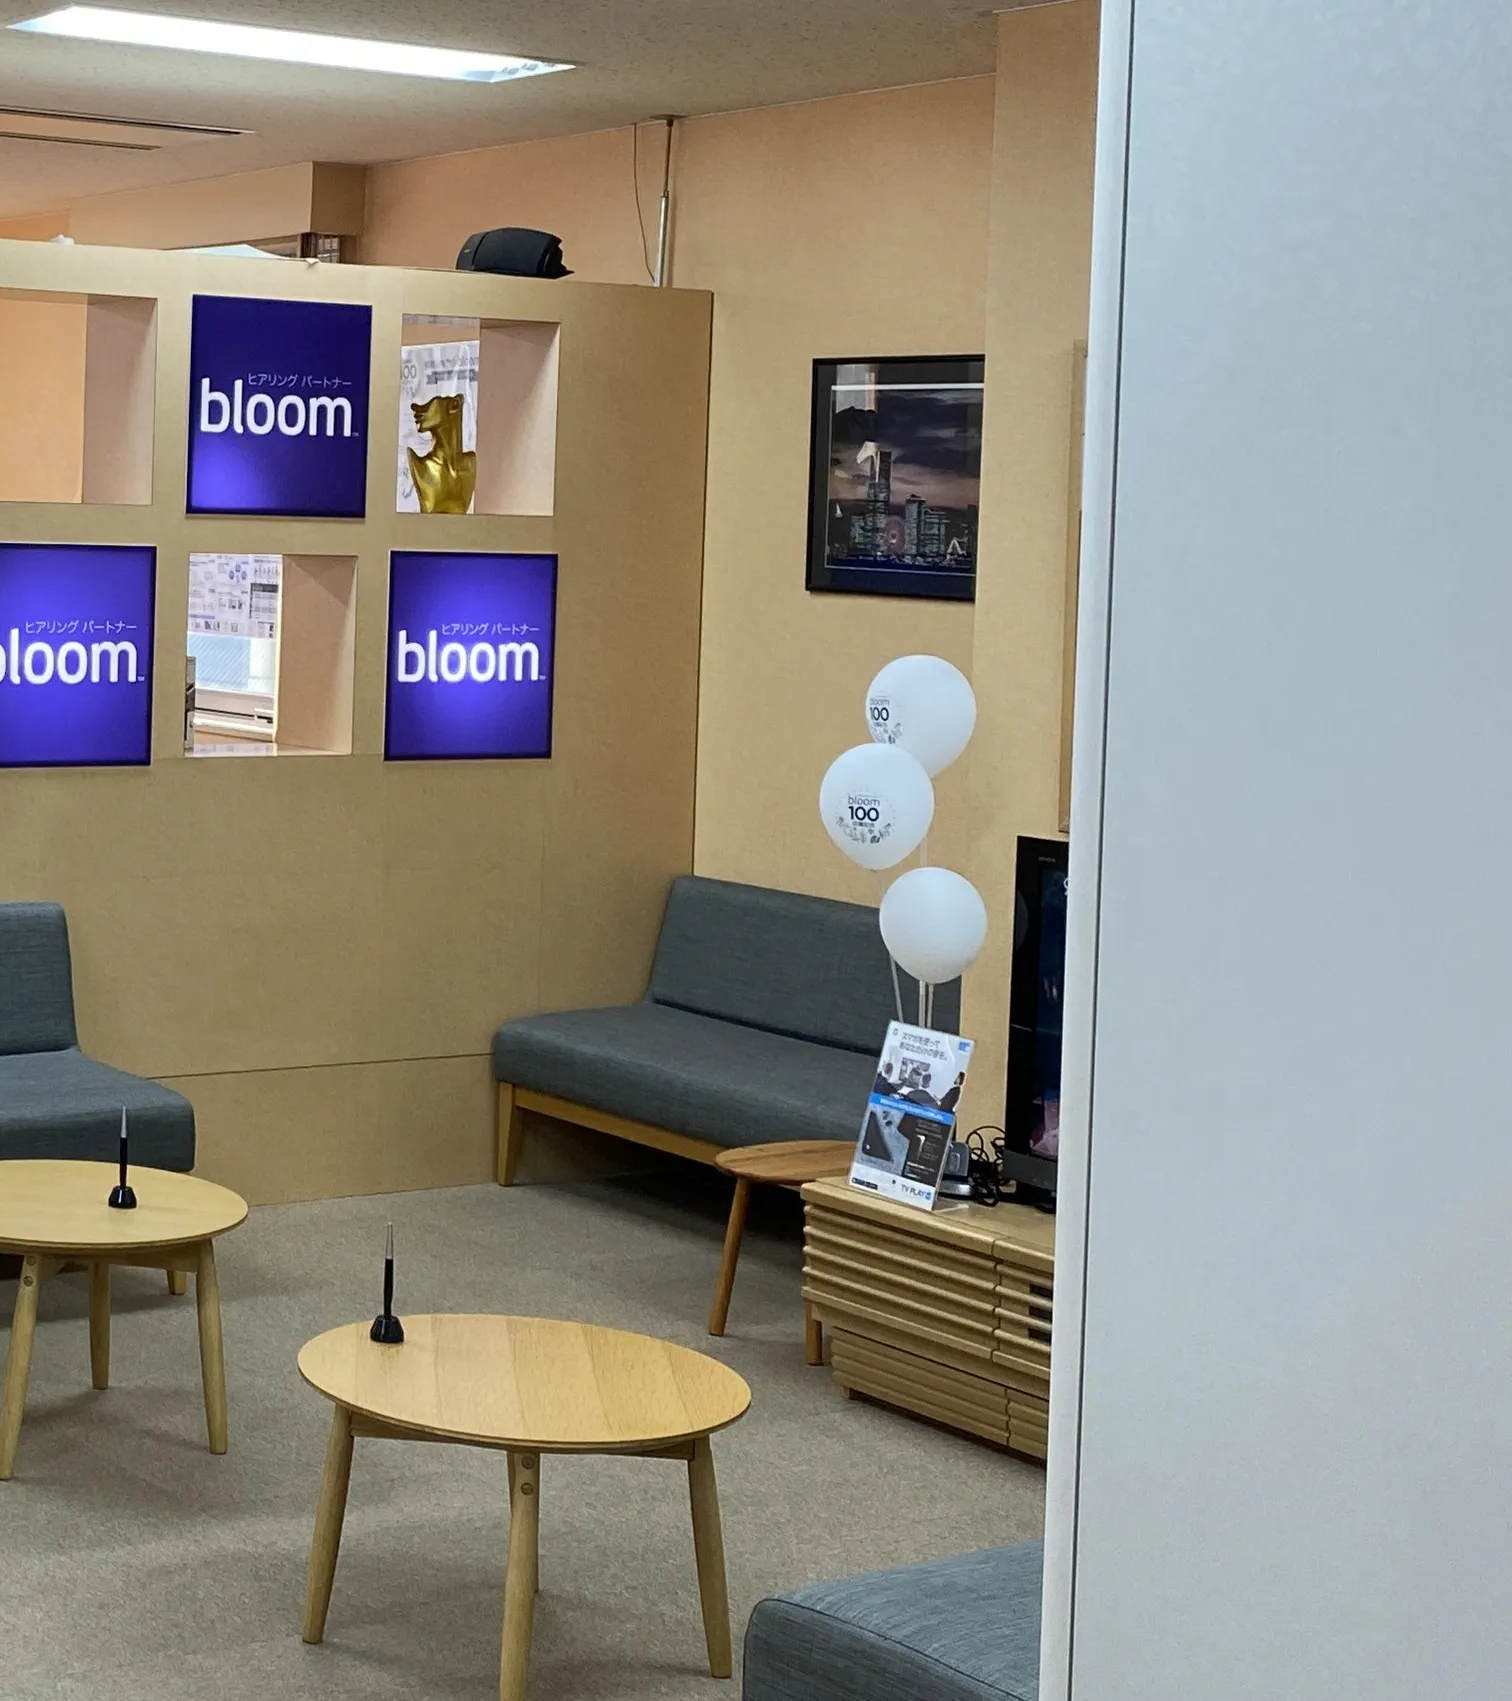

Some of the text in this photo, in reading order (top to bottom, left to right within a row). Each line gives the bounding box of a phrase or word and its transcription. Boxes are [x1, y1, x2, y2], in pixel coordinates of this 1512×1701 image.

[248, 373, 353, 389] ヒアリング パートナー
[200, 377, 352, 437] bloom
[25, 620, 137, 634] ヒアリング パートナー
[441, 623, 540, 636] ヒアリング パートナー
[397, 629, 539, 683] bloom
[869, 706, 889, 721] 100
[848, 794, 880, 807] bloom
[848, 806, 879, 822] 100
